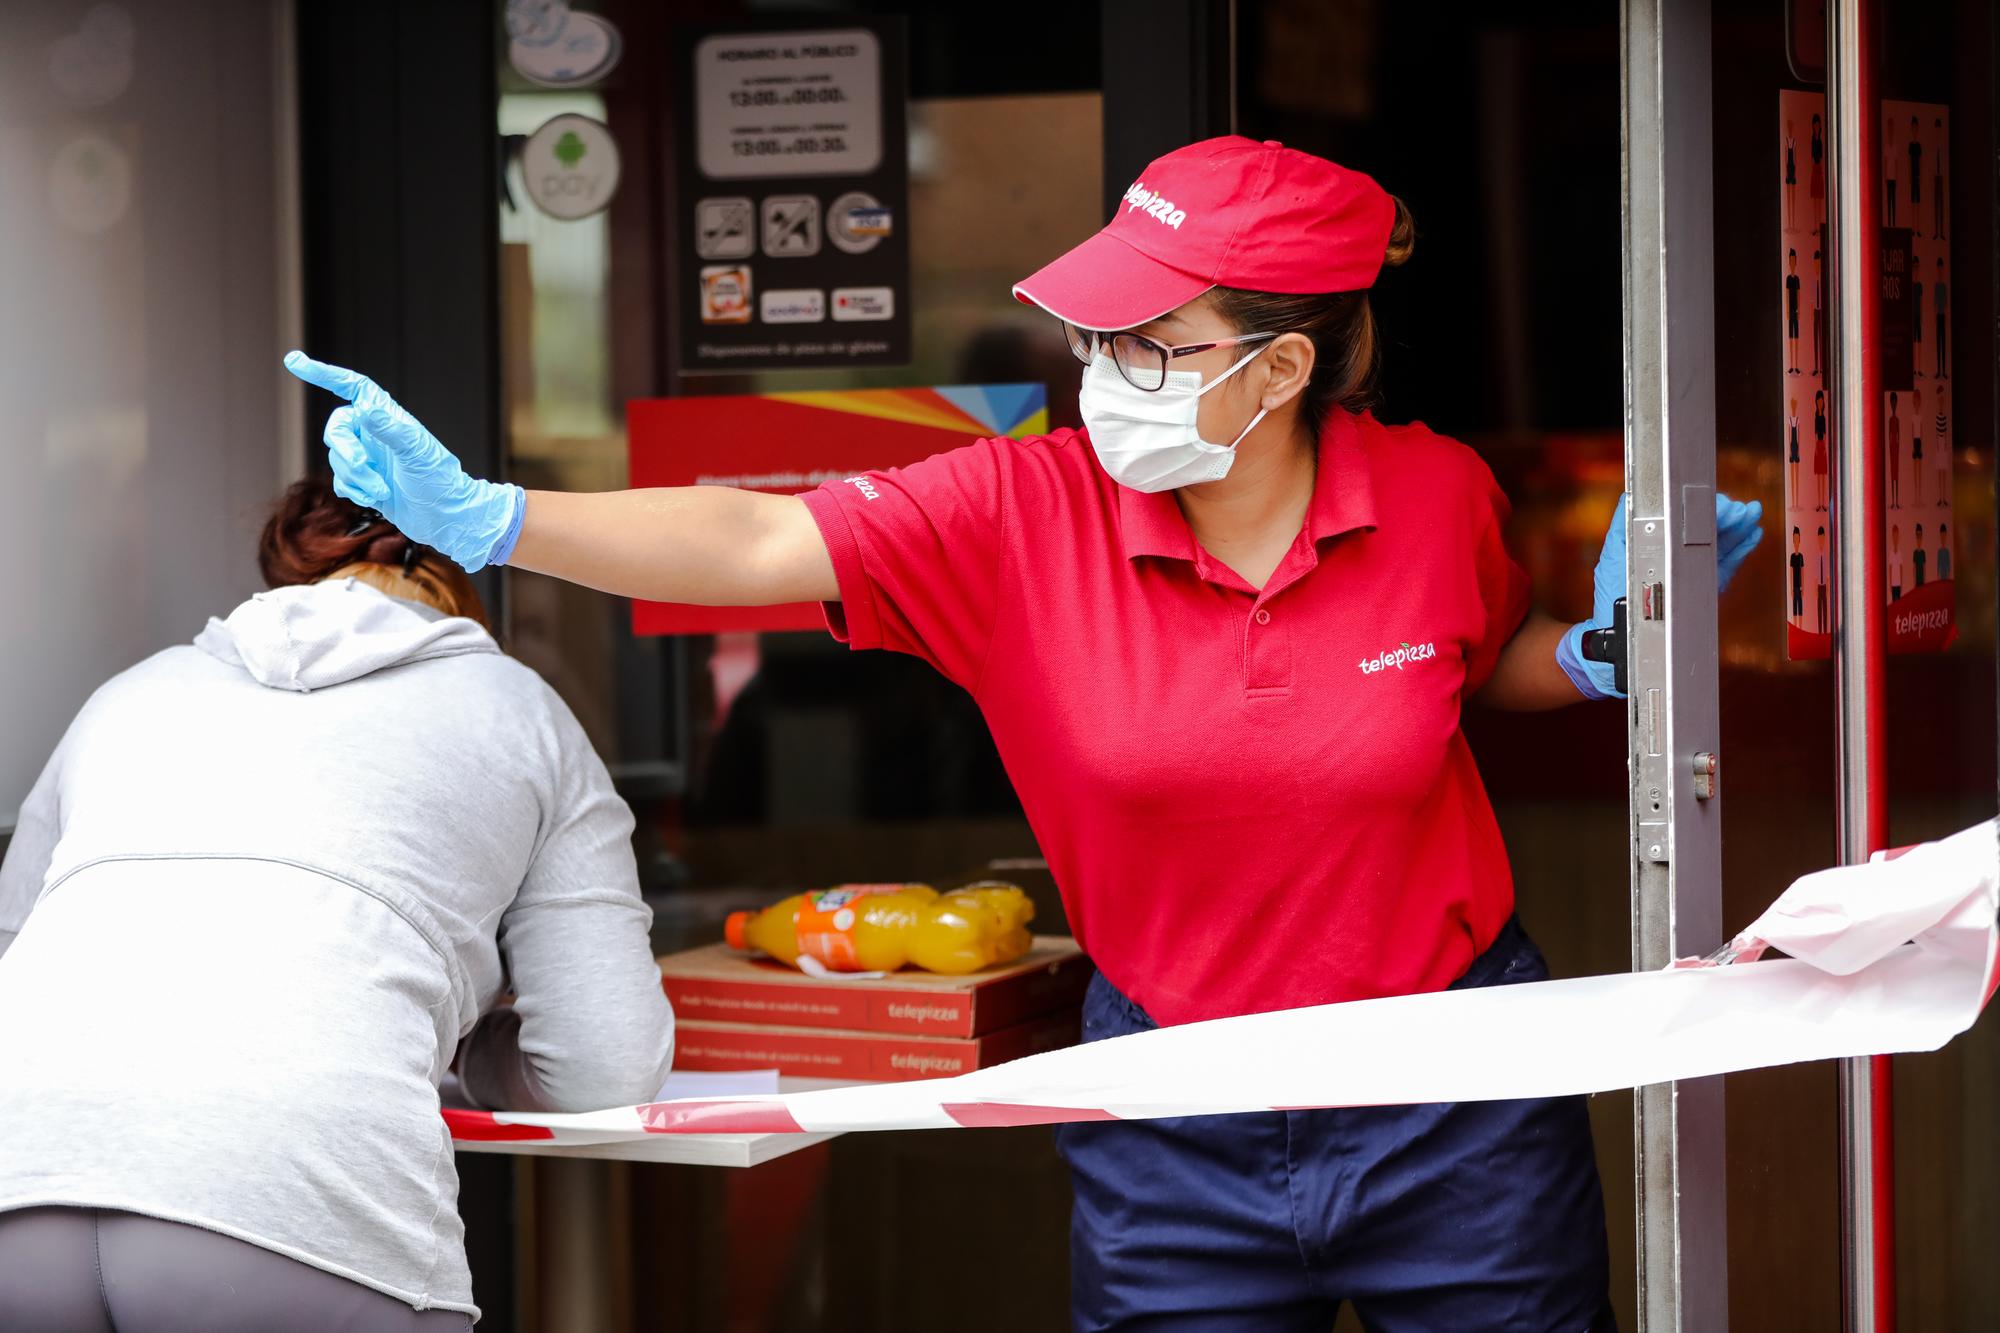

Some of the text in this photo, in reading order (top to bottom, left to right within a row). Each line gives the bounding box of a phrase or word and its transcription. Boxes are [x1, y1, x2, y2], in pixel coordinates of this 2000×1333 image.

[541, 173, 600, 201] pay
[1895, 607, 1949, 639] telepizza
[1358, 642, 1436, 675] telepizza
[888, 1003, 959, 1024] telepizza
[891, 1053, 962, 1074] telepizza
